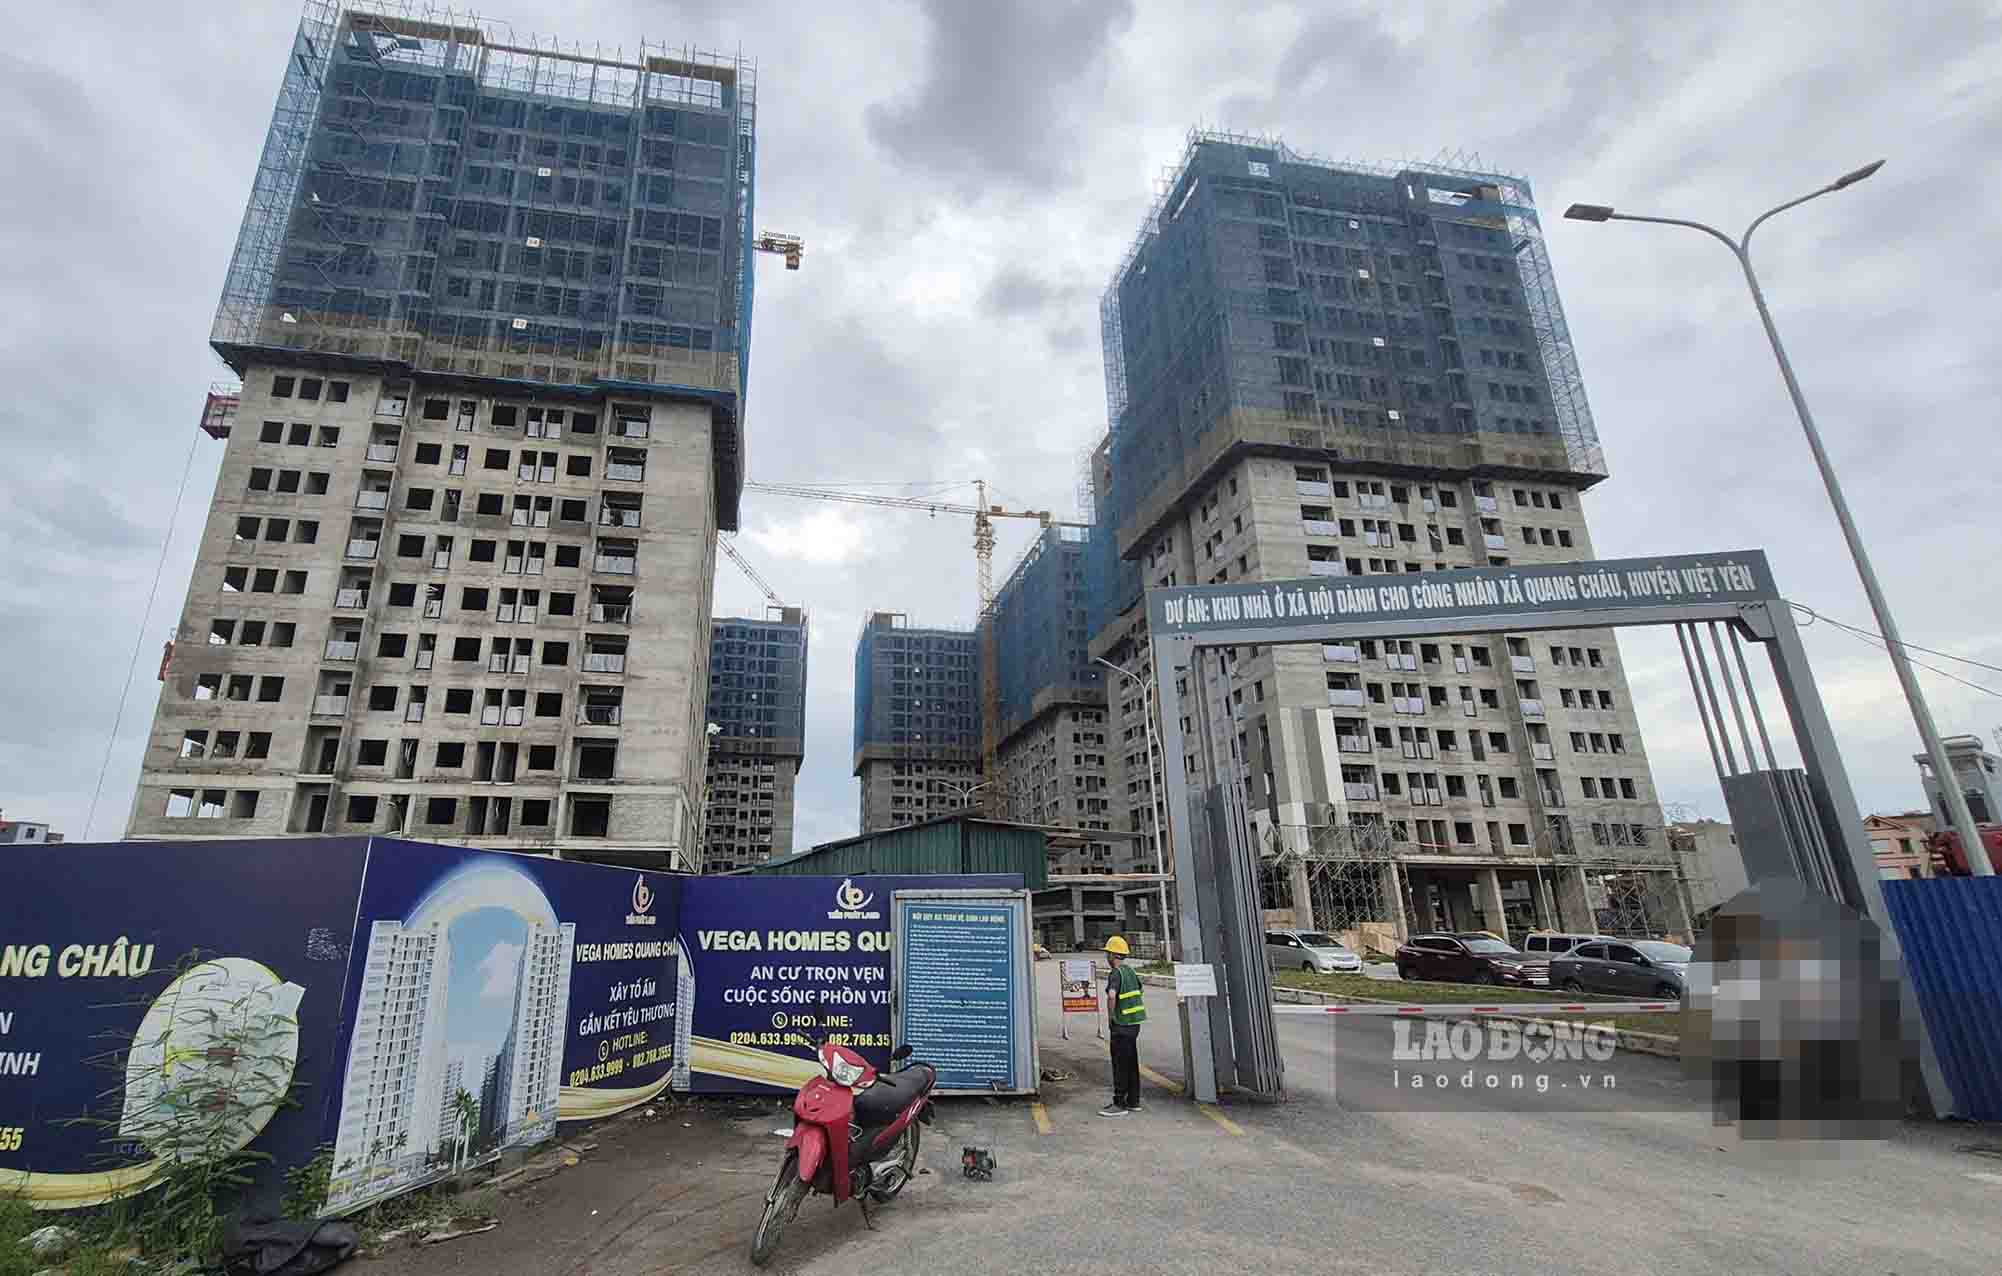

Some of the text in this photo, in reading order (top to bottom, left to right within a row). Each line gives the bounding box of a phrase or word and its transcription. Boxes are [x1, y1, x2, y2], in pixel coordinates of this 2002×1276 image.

[1165, 560, 1756, 629] DỰ ÁN: KHU NHÀ Ở XÃ HỘI DÀNH CHO CÔNG NHÂN XÃ QUANG CHÂU, HUYỆN VIỆT YÊN
[697, 930, 762, 951] VEGA
[767, 930, 851, 951] HOMES
[57, 936, 155, 978] CHÂU
[576, 944, 602, 963] VEGA
[603, 942, 633, 960] HOMES
[635, 941, 661, 959] QUANG
[750, 965, 884, 984] AN CƯ TRỌN VẸN
[609, 981, 630, 1002] XÂY
[723, 985, 768, 1007] CUỘC
[771, 985, 816, 1004] SỐNG
[820, 985, 866, 1004] PHỒN
[579, 1002, 675, 1036] GẮN KẾT YÊU THƯƠNG
[612, 1031, 648, 1053] HOTLINE:
[0, 1127, 24, 1151] 55
